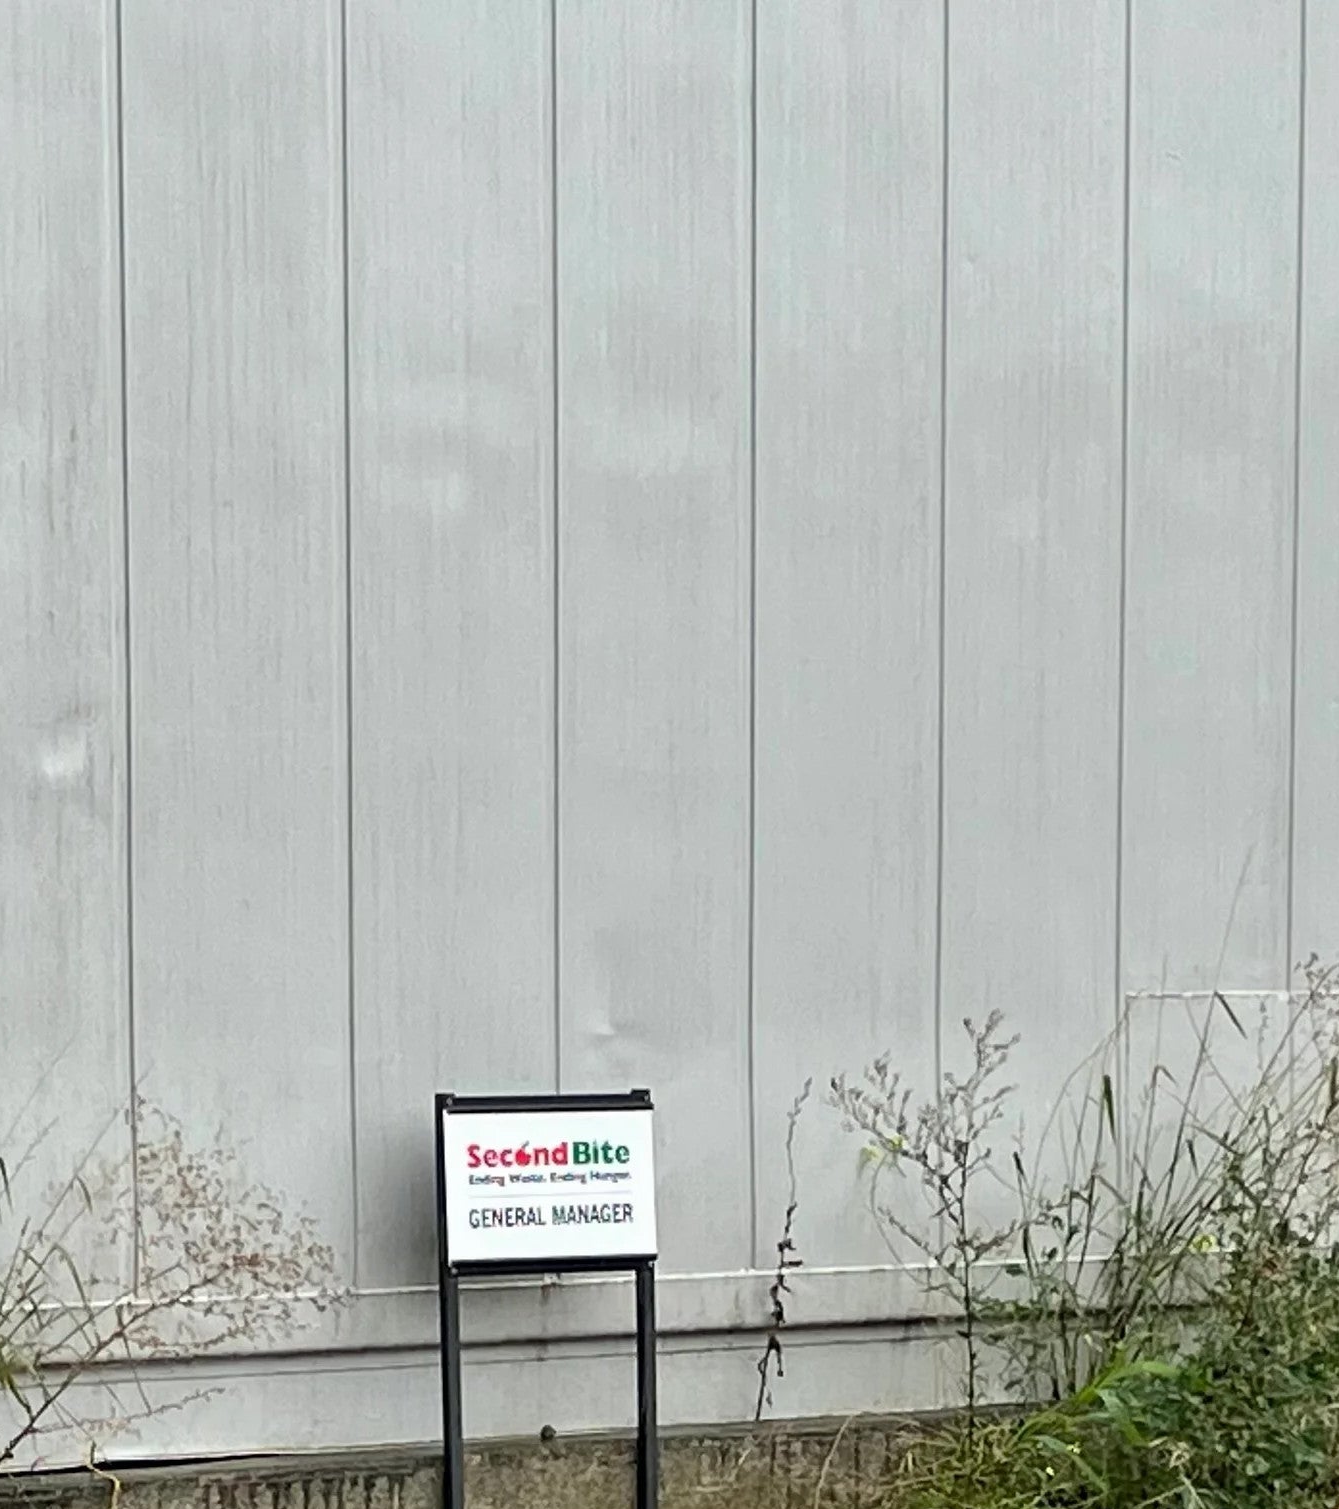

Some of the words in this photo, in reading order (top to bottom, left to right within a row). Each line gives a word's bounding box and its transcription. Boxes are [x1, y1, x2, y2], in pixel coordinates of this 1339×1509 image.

[467, 1141, 630, 1168] SecondBite
[468, 1207, 547, 1229] GENERAL
[552, 1203, 634, 1225] MANAGER
